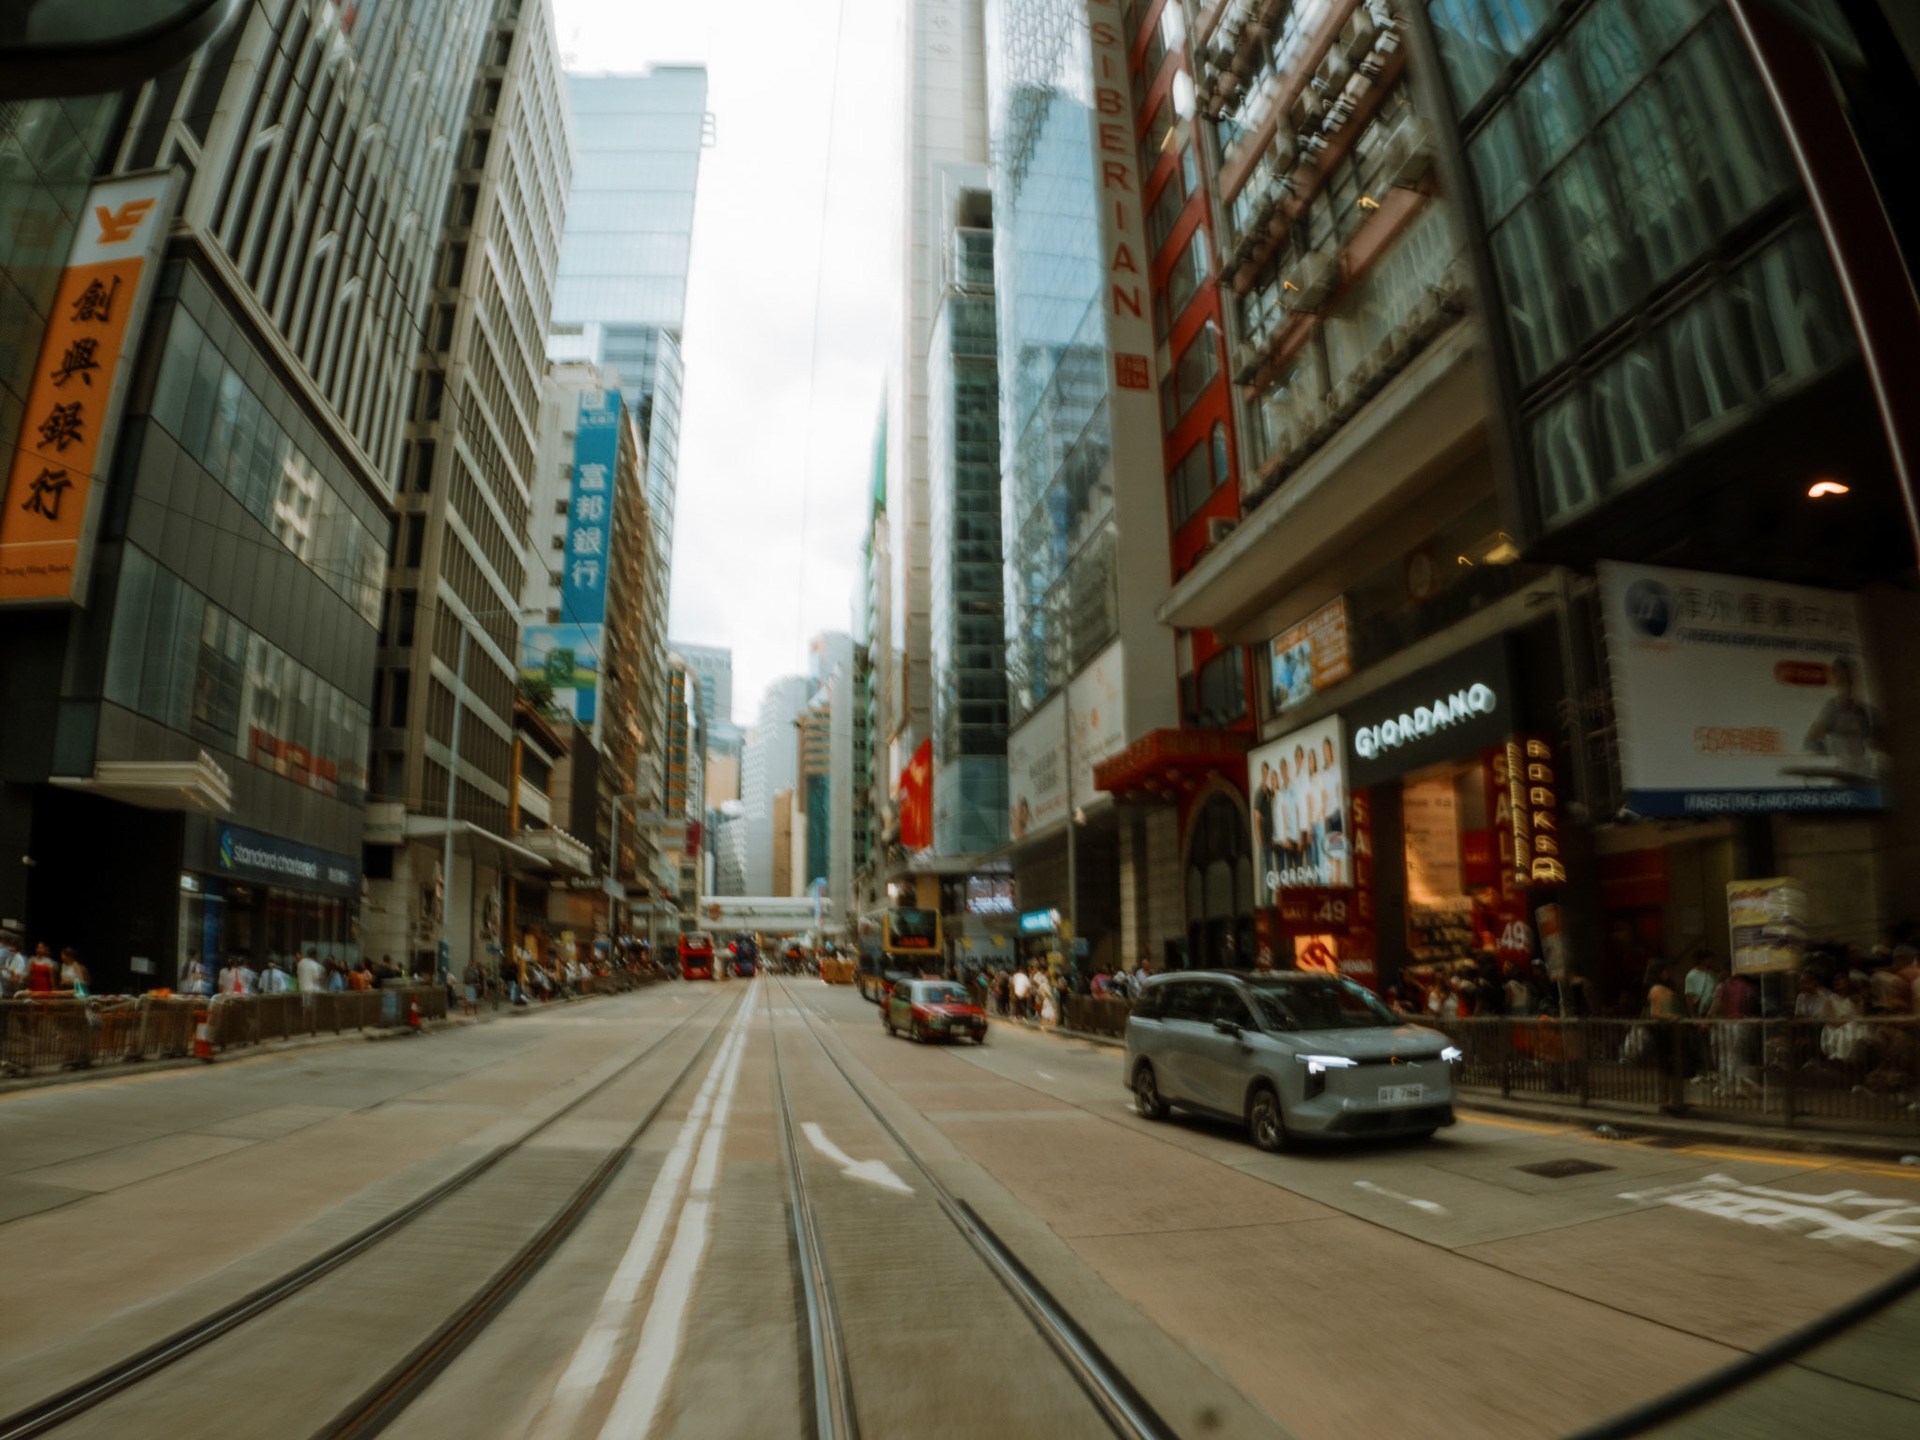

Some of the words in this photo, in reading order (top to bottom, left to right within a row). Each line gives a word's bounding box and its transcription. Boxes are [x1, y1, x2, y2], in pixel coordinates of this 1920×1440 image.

[1091, 22, 1143, 320] SIBERIAN
[21, 274, 121, 521] 創興銀行
[570, 462, 607, 590] 富邦銀行
[1354, 681, 1497, 760] GIORDANO
[234, 844, 276, 869] standard
[278, 854, 317, 879] chartered
[1353, 797, 1372, 917] SALE
[1492, 752, 1516, 900] SALE
